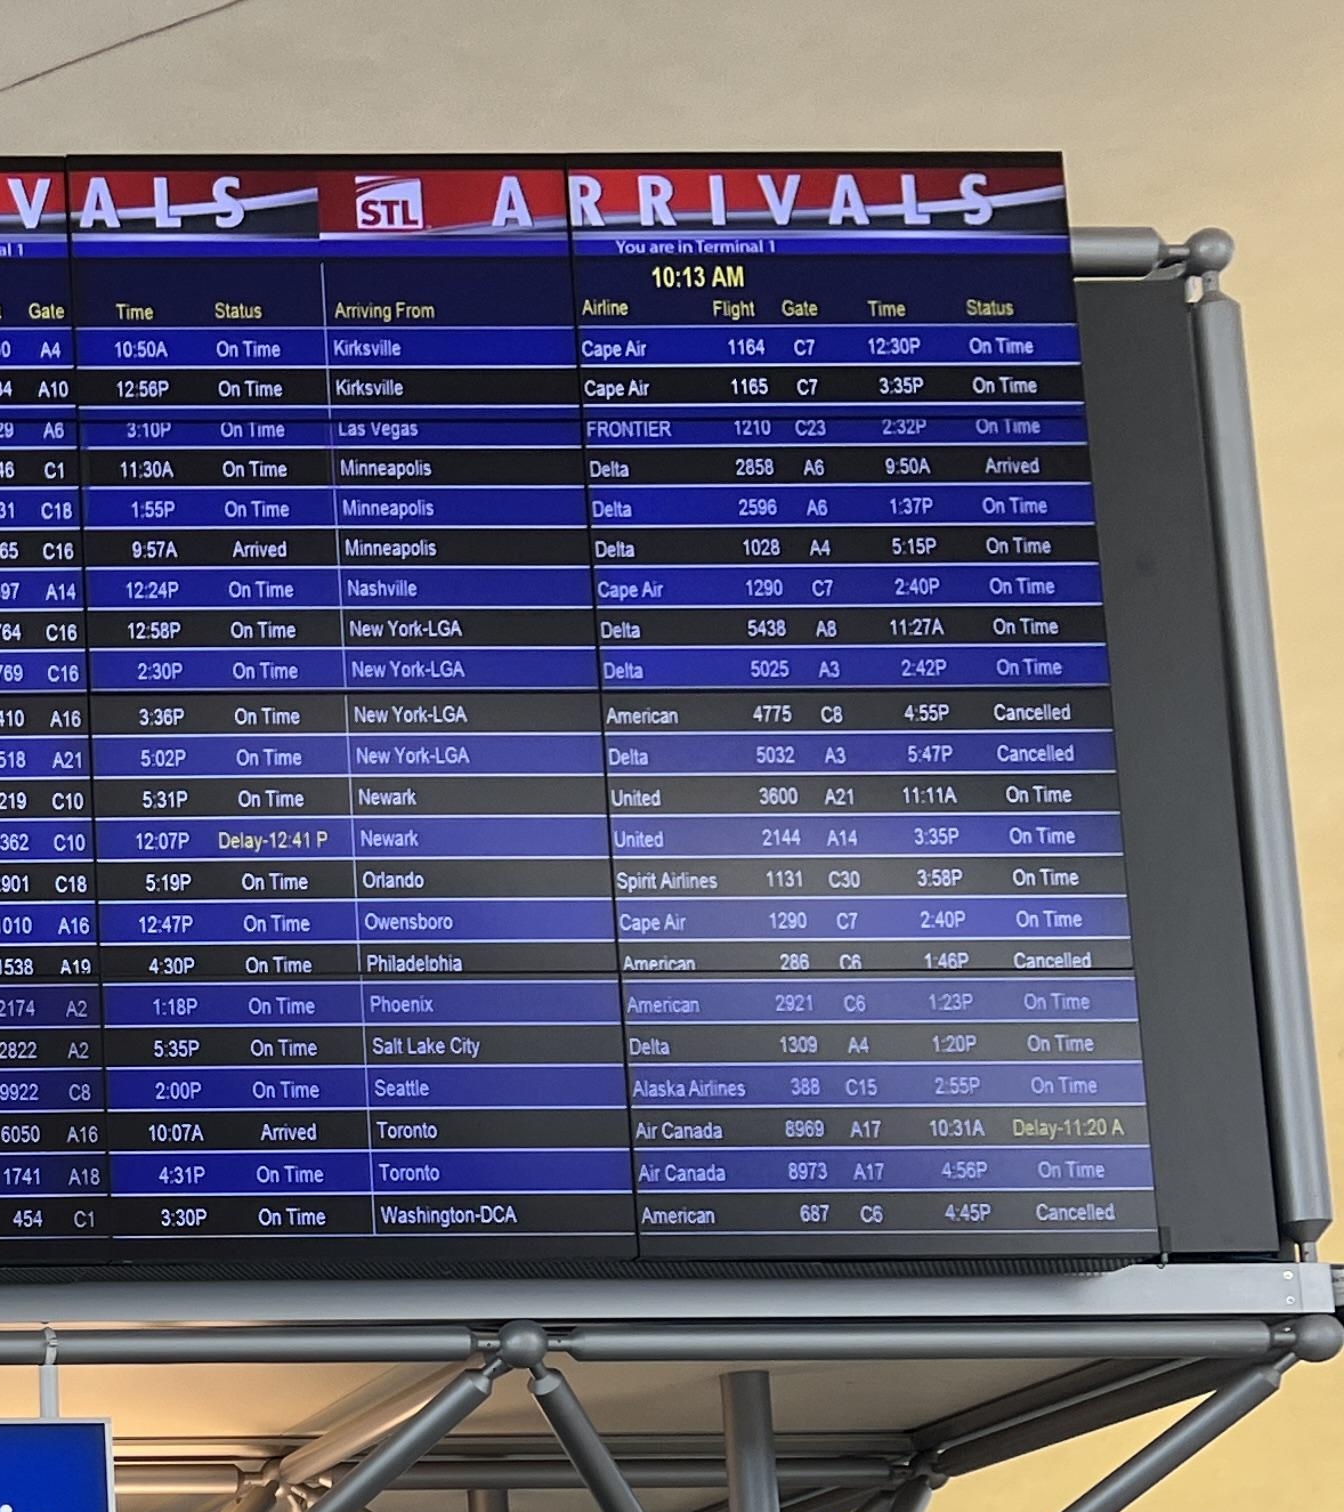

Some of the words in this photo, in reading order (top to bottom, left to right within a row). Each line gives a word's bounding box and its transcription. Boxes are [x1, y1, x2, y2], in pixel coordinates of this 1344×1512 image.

[362, 200, 419, 226] STL
[492, 174, 994, 228] ARRIVALS
[652, 267, 705, 289] 10:13
[712, 266, 744, 288] AM
[333, 340, 401, 356] Kirksville
[582, 341, 622, 360] Cape
[626, 340, 647, 356] Air
[728, 339, 765, 355] 1164
[794, 339, 815, 356] C7
[868, 338, 921, 355] 12:30P
[969, 339, 995, 355] On
[1000, 338, 1033, 355] Time
[54, 834, 85, 852] C10
[136, 832, 189, 851] 12:07P
[218, 832, 311, 852] Delay-12:41
[317, 832, 327, 849] P
[377, 1121, 438, 1140] Toronto
[636, 1122, 659, 1140] Air
[662, 1122, 722, 1140] Canada
[785, 1120, 824, 1138] 8969
[850, 1120, 881, 1138] A17
[929, 1119, 985, 1138] 10:31A
[1013, 1119, 1107, 1139] Delay-11:20
[1111, 1119, 1124, 1136] A
